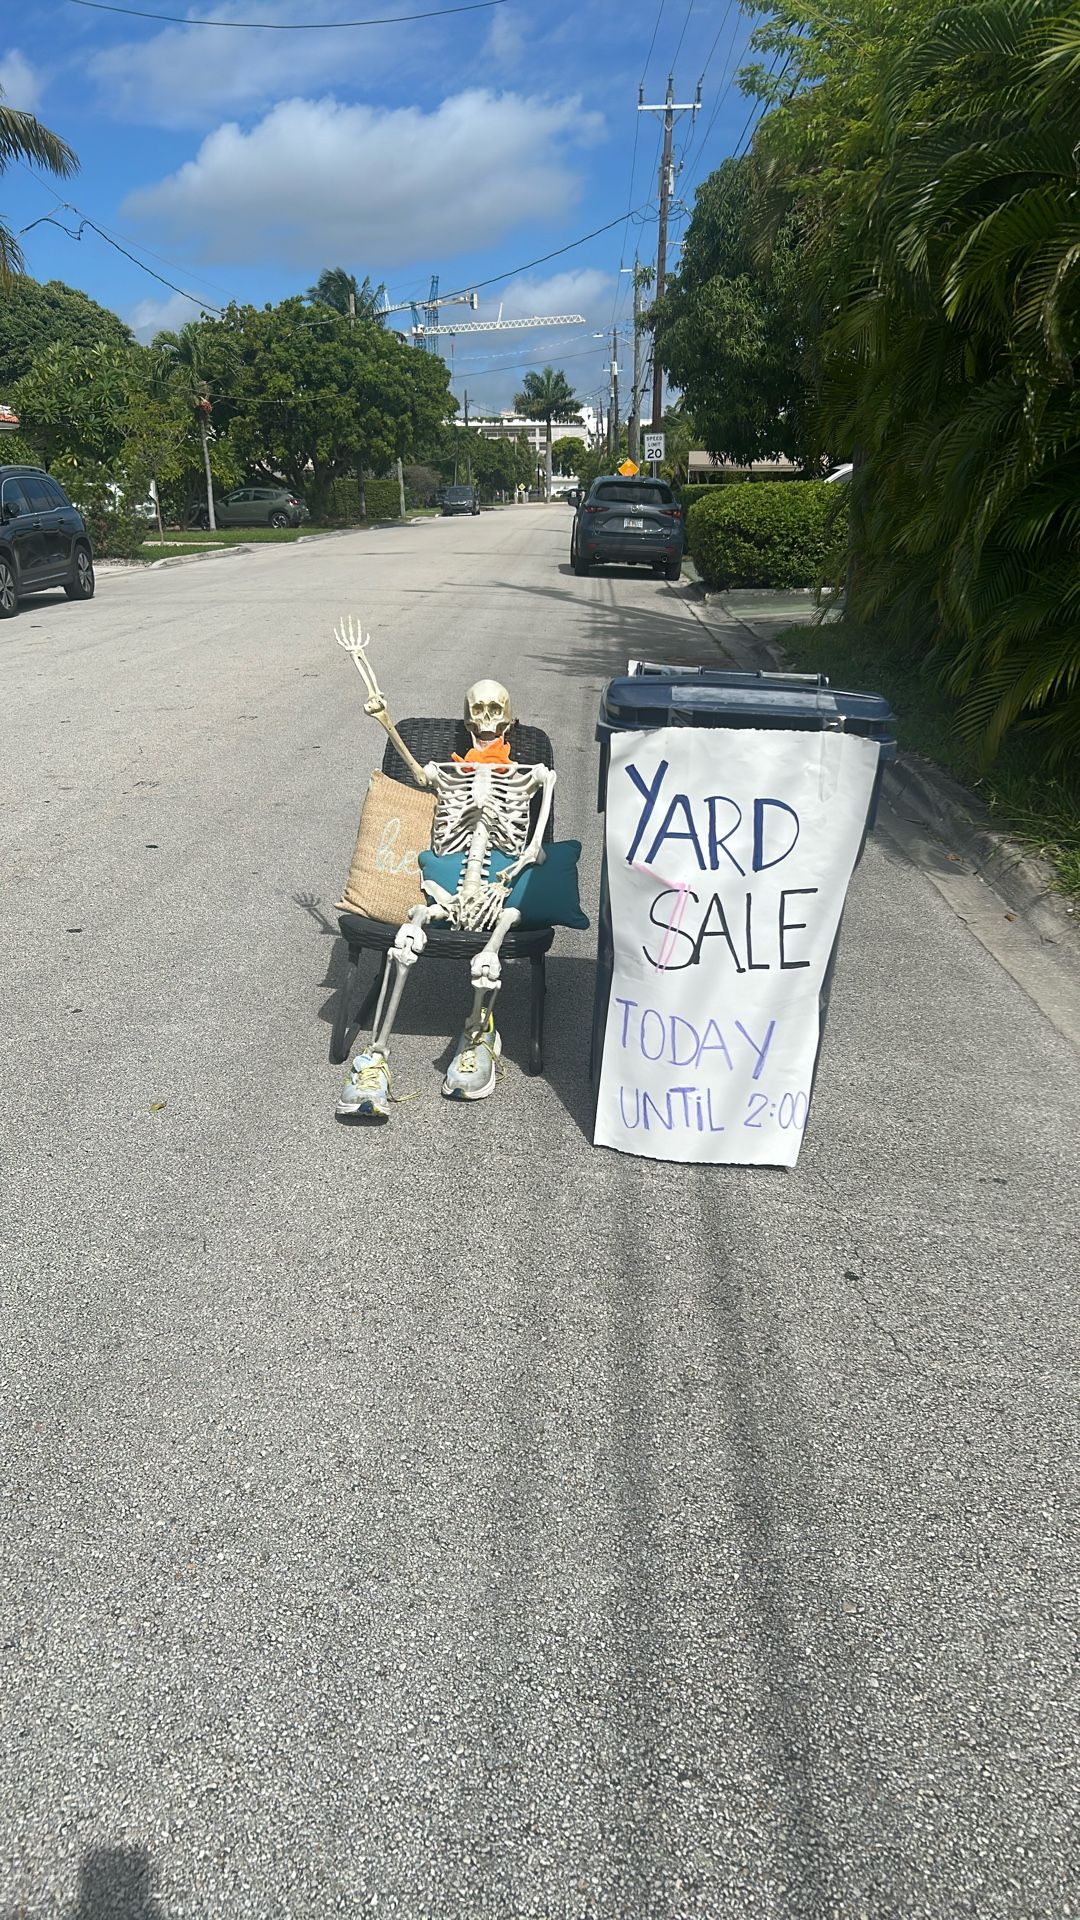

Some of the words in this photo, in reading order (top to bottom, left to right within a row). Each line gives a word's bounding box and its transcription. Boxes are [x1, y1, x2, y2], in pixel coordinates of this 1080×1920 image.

[647, 448, 662, 459] 20
[375, 816, 421, 875] he
[625, 760, 799, 876] YARD
[642, 887, 819, 974] SALE
[615, 997, 776, 1080] TODAY
[743, 1091, 808, 1130] 2:00
